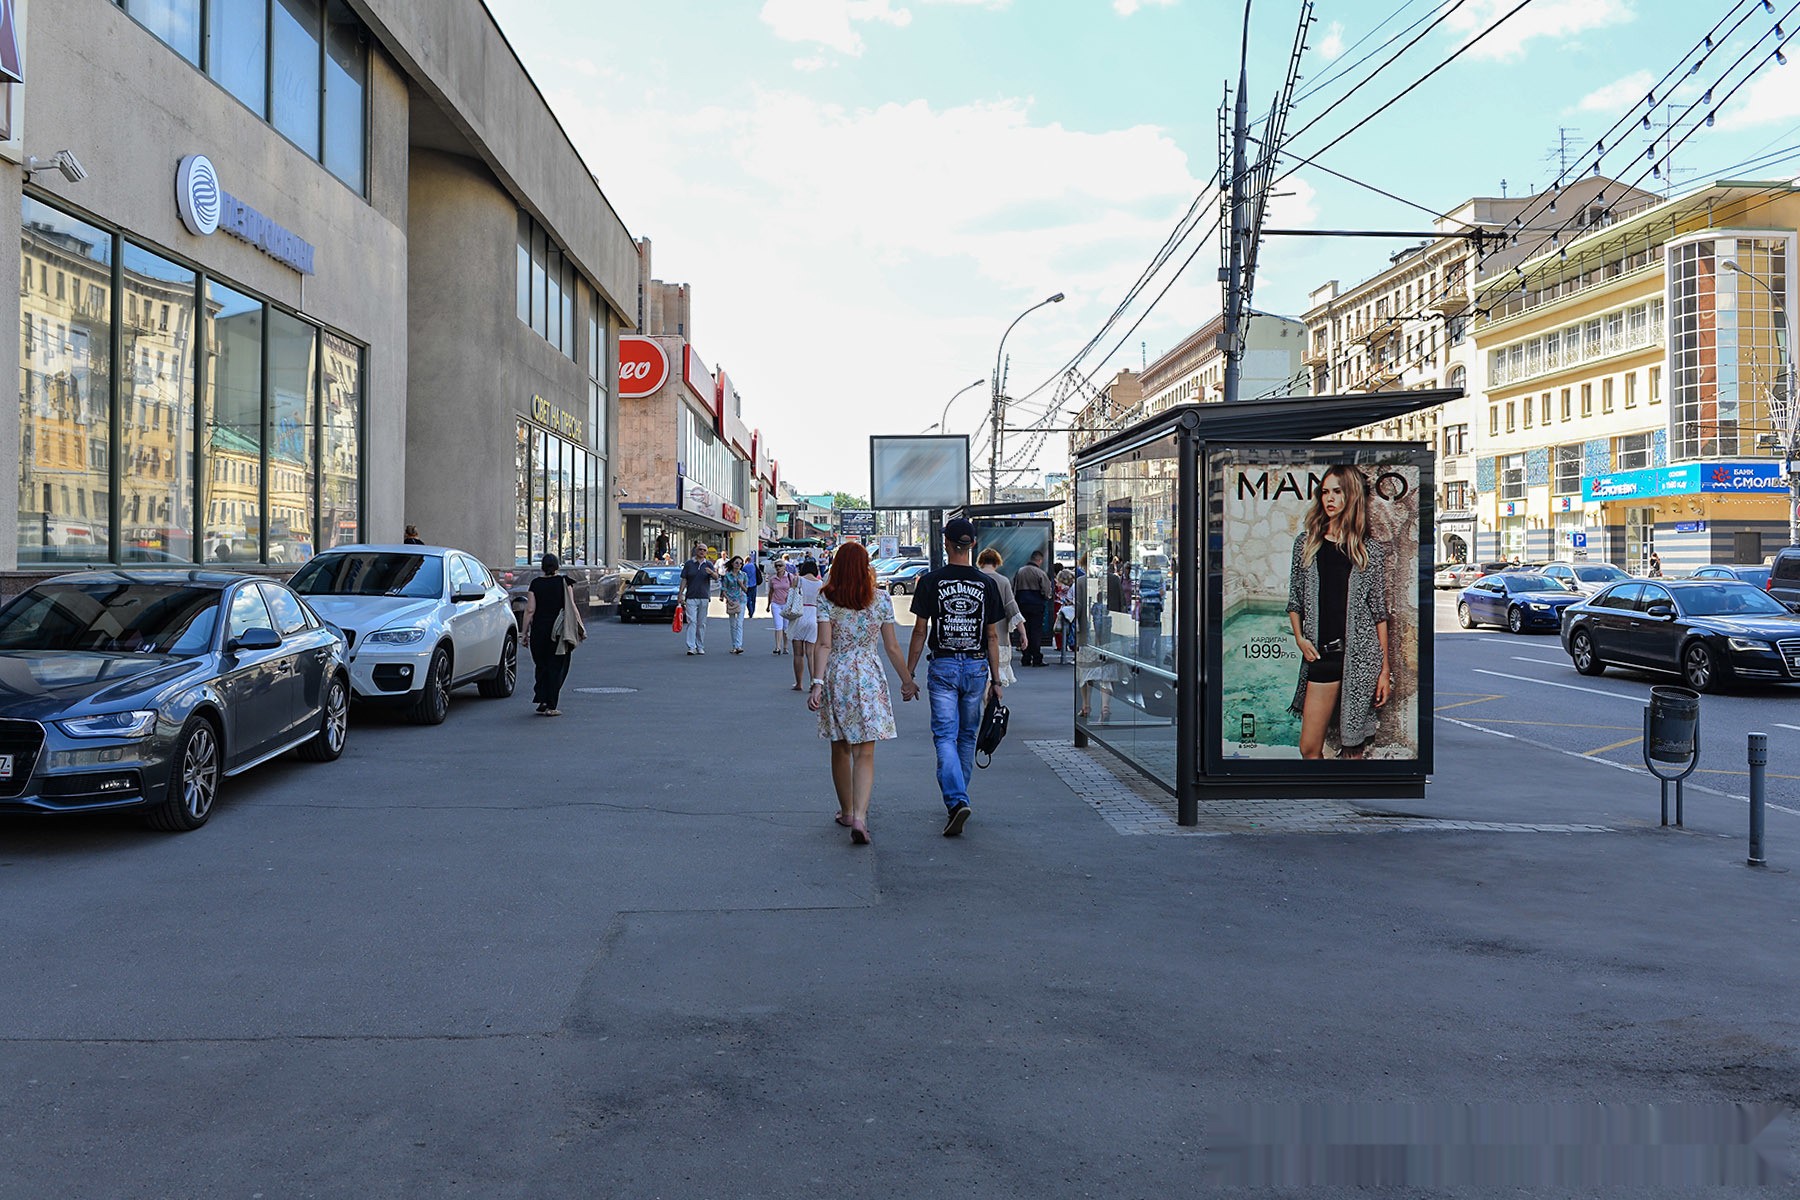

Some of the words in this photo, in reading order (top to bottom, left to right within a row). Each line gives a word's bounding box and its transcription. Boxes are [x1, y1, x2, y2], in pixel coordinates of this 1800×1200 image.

[1238, 472, 1408, 502] MANO
[938, 585, 957, 600] JACK
[957, 582, 984, 601] DANIEL'S
[1242, 644, 1281, 659] 1.999
